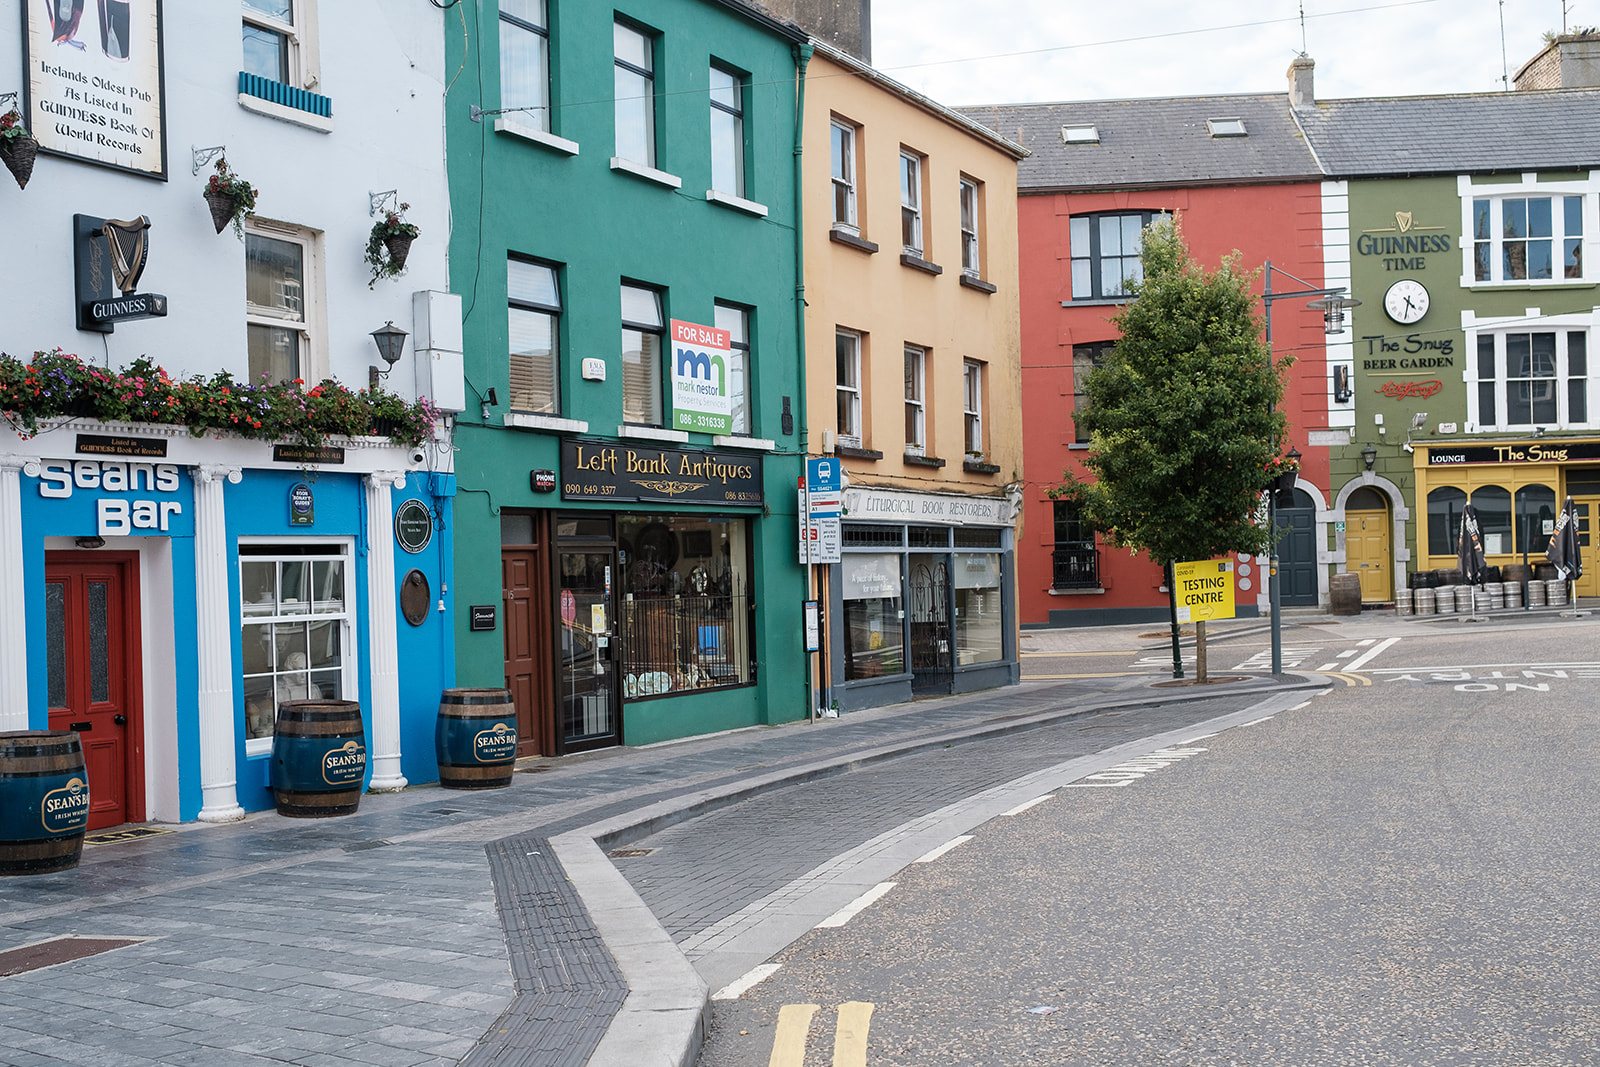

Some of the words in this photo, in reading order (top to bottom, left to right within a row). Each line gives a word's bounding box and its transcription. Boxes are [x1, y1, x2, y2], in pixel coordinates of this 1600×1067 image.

[41, 60, 89, 85] Irelands
[91, 76, 126, 96] Oldest
[130, 86, 152, 103] Pub
[64, 86, 81, 101] As
[84, 92, 119, 112] Listed
[122, 103, 132, 115] In
[40, 100, 107, 127] GUINNESS
[110, 118, 138, 136] Book
[141, 127, 154, 140] Of
[55, 123, 93, 142] World
[96, 133, 143, 155] Records
[1357, 233, 1451, 256] GUINNESS
[1383, 257, 1426, 271] TIME
[93, 298, 147, 318] GUINNESS
[677, 325, 698, 342] FOR
[699, 328, 723, 347] SALE
[1361, 334, 1400, 355] The
[1403, 333, 1454, 355] Snug
[1363, 359, 1397, 370] BEER
[1399, 357, 1454, 369] GARDEN
[677, 380, 696, 393] mark
[696, 384, 719, 396] nestor
[680, 413, 693, 425] 086
[697, 415, 726, 429] 3316338
[1431, 454, 1466, 463] LOUNGE
[1493, 445, 1525, 463] The
[1528, 445, 1568, 462] Snug
[576, 446, 618, 475] Left
[626, 450, 671, 475] Bank
[679, 455, 752, 485] Antiques
[40, 460, 179, 498] Seans
[536, 474, 555, 482] PHONE
[565, 483, 581, 494] 090
[583, 484, 598, 495] 649
[600, 485, 616, 495] 3377
[724, 491, 737, 500] 086
[921, 500, 945, 515] BOOK
[97, 499, 182, 536] Bar
[1183, 576, 1225, 591] TESTING
[1185, 591, 1224, 606] CENTRE
[477, 735, 506, 748] SEAN'S
[326, 754, 356, 769] SEAN'S
[46, 794, 82, 813] SEAN'S
